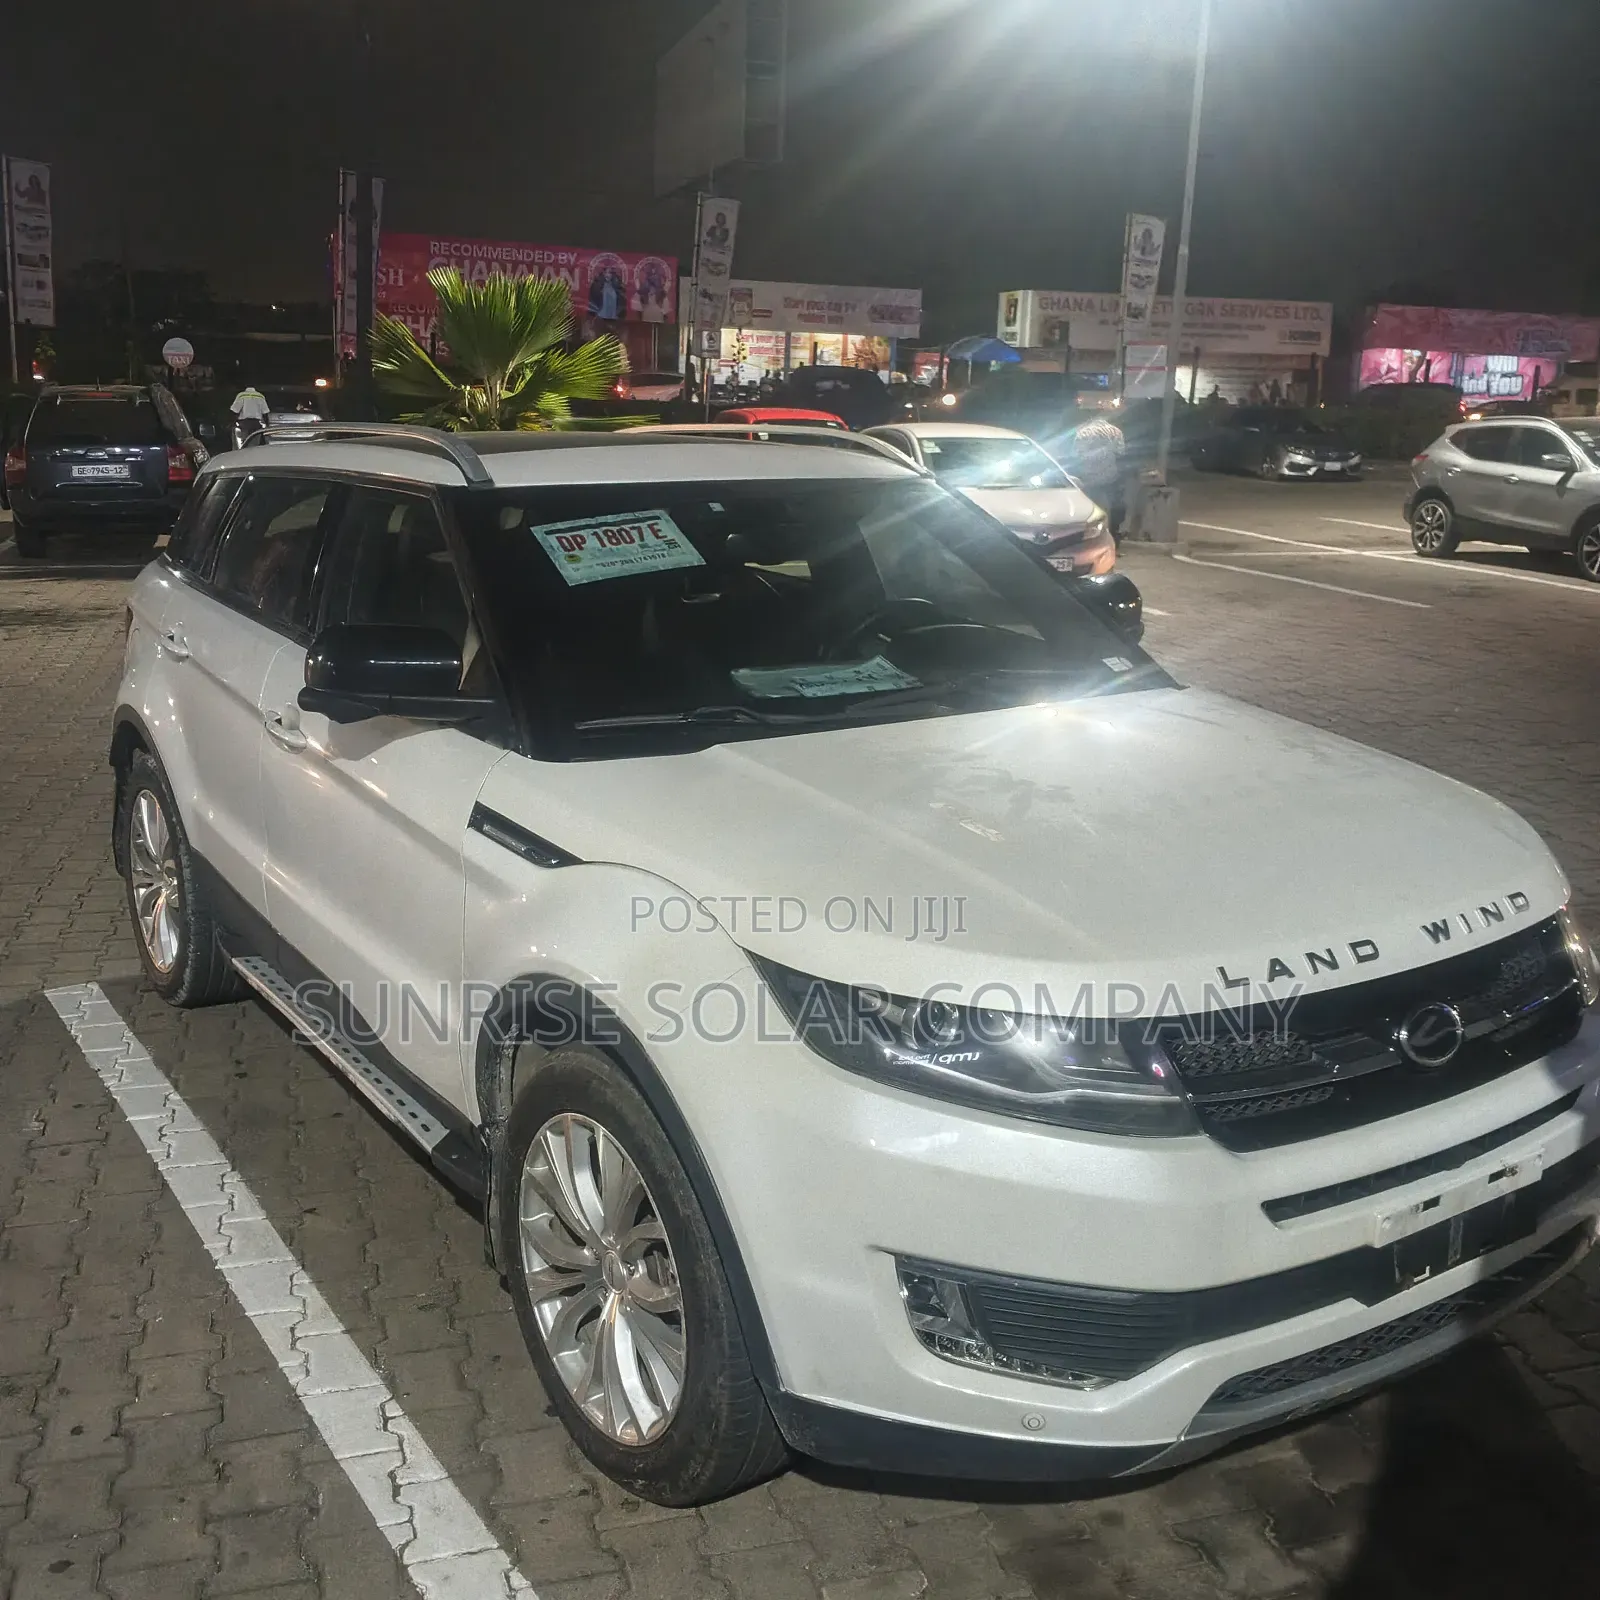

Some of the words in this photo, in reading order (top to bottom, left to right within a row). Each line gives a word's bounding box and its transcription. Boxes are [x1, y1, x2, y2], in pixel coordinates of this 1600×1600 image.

[430, 240, 555, 263] RECOMMENDED
[557, 251, 578, 266] BY
[1039, 297, 1095, 313] GHANA
[1220, 303, 1290, 320] SERVICES
[555, 532, 587, 553] DP
[591, 525, 645, 548] 1807
[647, 522, 668, 540] E
[1215, 938, 1380, 990] LAND
[1419, 890, 1531, 945] WIND
